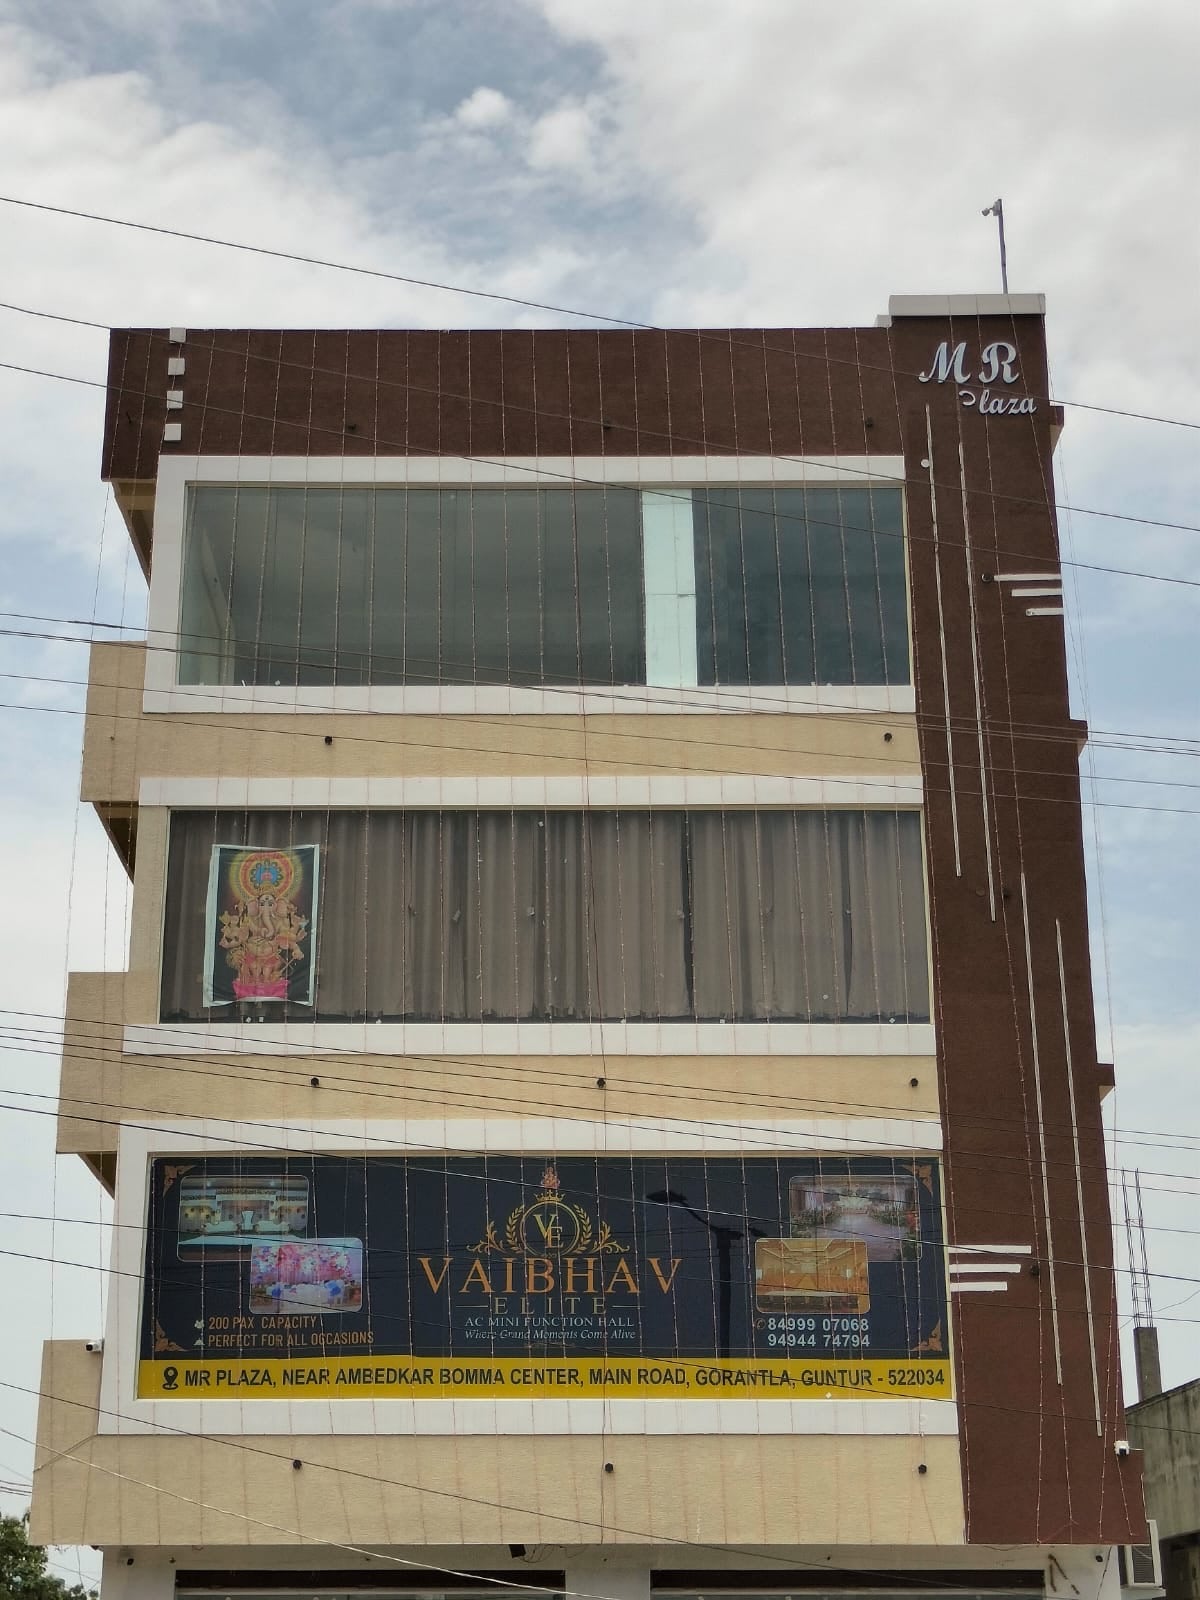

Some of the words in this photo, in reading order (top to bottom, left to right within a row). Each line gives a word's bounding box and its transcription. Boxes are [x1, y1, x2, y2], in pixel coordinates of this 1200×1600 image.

[417, 1257, 682, 1294] VAIBHAV
[494, 1297, 607, 1315] ELITE
[208, 1317, 229, 1330] 200
[232, 1316, 255, 1330] PAX
[261, 1315, 318, 1329] CAPACITY
[464, 1317, 484, 1327] AC
[488, 1317, 519, 1327] MINI
[525, 1317, 593, 1327] FUNCTION
[599, 1317, 635, 1327] HALL
[767, 1318, 816, 1331] 84999
[822, 1318, 869, 1331] 07068
[208, 1334, 257, 1347] PERFECT
[261, 1333, 284, 1346] FOR
[287, 1332, 308, 1346] ALL
[311, 1331, 375, 1345] OCCASIONS
[465, 1329, 497, 1339] Where
[500, 1329, 531, 1339] Grand
[533, 1329, 578, 1340] Moments
[580, 1329, 608, 1339] Come
[611, 1329, 636, 1339] Alive
[767, 1333, 817, 1347] 94944
[823, 1334, 870, 1347] 74794
[185, 1370, 211, 1386] MR
[216, 1369, 277, 1389] PLAZA,
[282, 1369, 330, 1385] NEAR
[335, 1368, 434, 1385] AMBEDKAR
[439, 1368, 505, 1385] BOMMA
[510, 1368, 584, 1388] CENTER,
[589, 1368, 632, 1385] MAIN
[637, 1368, 690, 1389] ROAD,
[695, 1369, 796, 1389] GORANTLA,
[801, 1369, 873, 1386] GUNTUR
[888, 1369, 945, 1386] 522034
